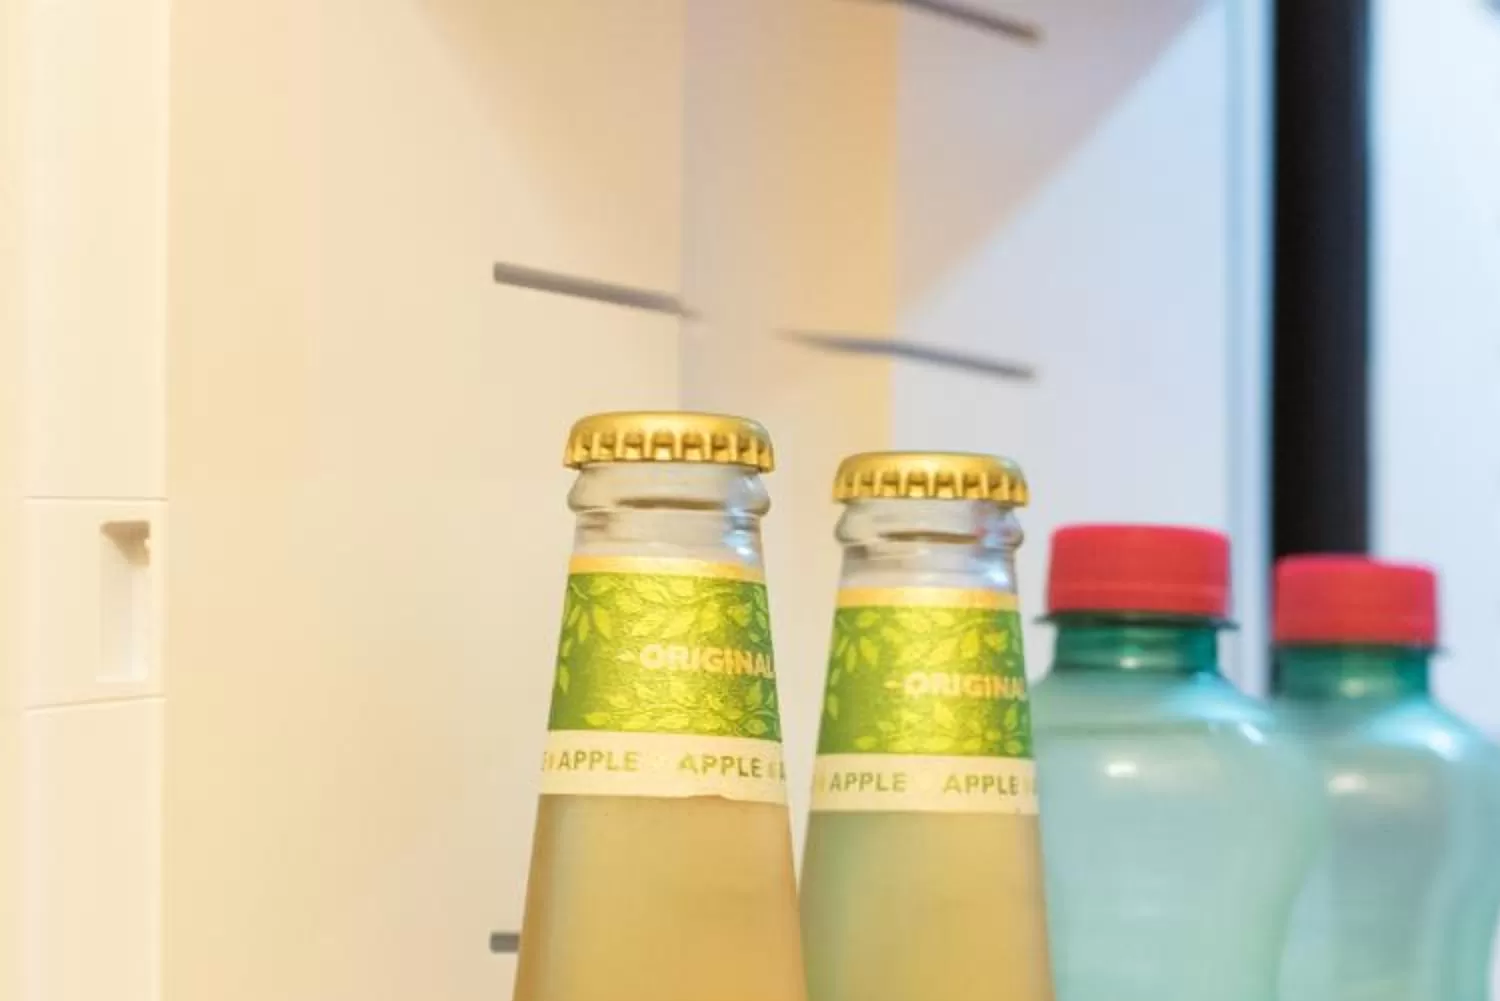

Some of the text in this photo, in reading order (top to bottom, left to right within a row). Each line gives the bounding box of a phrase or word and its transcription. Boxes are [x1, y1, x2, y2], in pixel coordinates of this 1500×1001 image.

[639, 643, 774, 680] ORIGINAL
[557, 750, 640, 772] APPLE
[677, 752, 764, 778] APPLE
[828, 771, 1019, 797] APPLE APPLE
